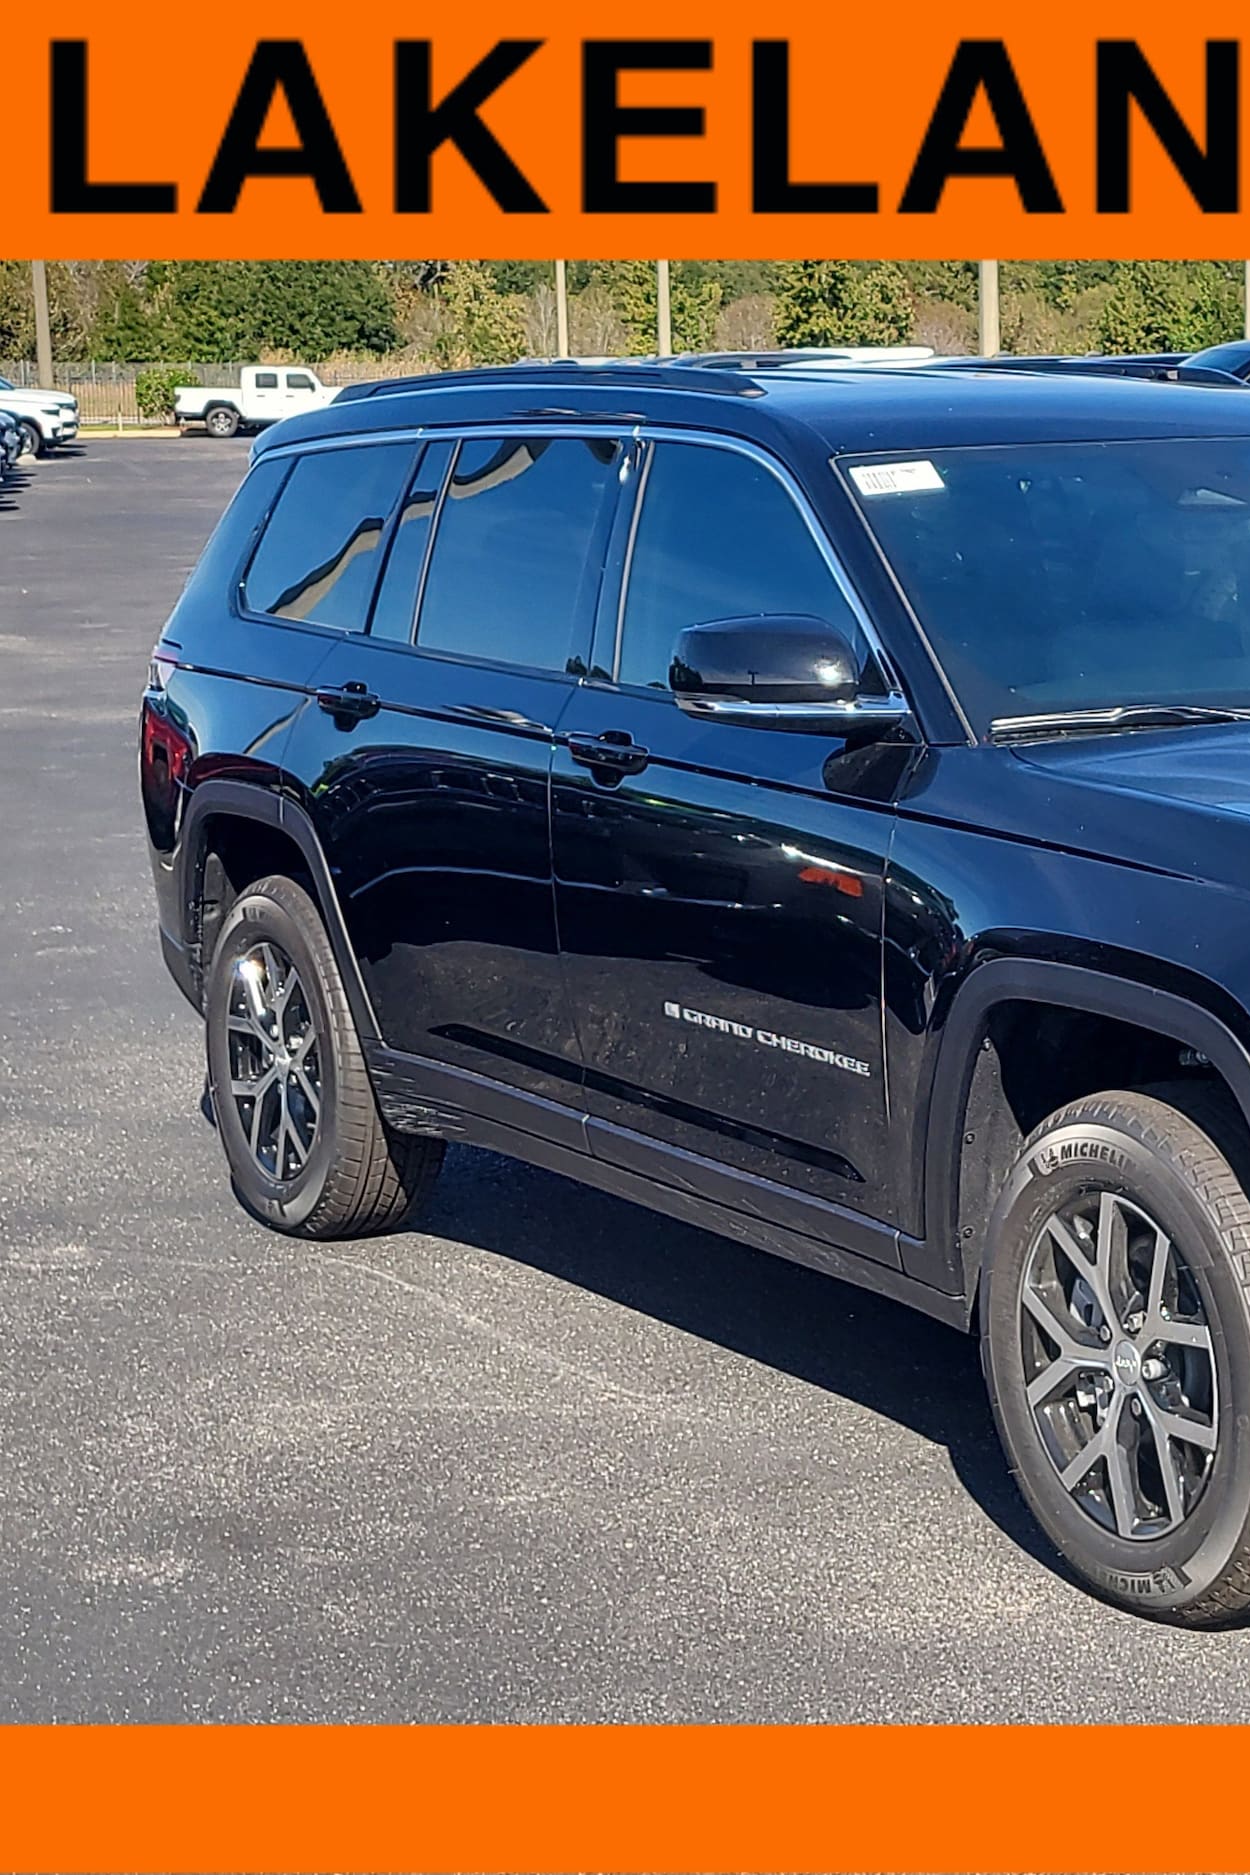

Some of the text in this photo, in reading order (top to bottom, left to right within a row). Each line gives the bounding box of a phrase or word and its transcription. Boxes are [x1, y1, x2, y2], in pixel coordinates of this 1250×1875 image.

[683, 1008, 754, 1039] GRAND
[756, 1030, 871, 1078] CHEROKEE
[1060, 1143, 1137, 1175] MICHELIN
